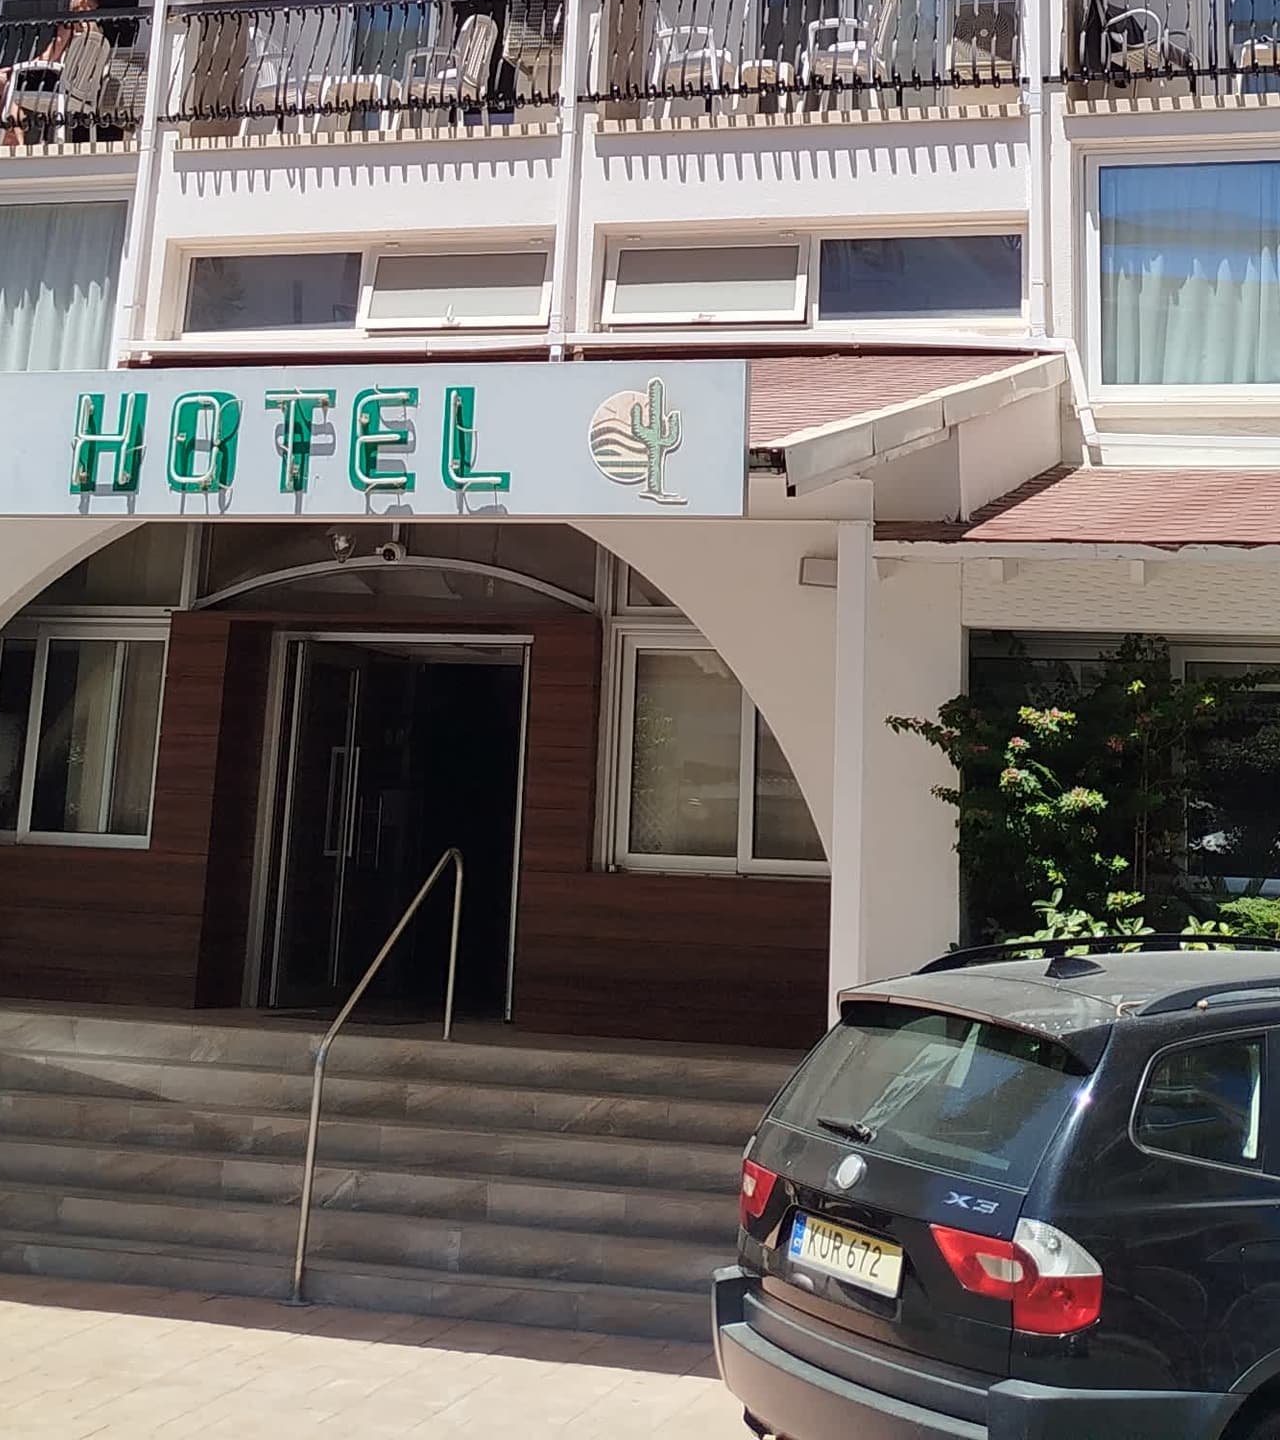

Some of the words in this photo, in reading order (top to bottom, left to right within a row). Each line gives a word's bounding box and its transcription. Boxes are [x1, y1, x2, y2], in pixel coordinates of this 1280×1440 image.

[69, 384, 511, 495] HOTEL
[943, 1191, 999, 1214] X3
[806, 1222, 844, 1266] KUR
[846, 1237, 882, 1279] 672
